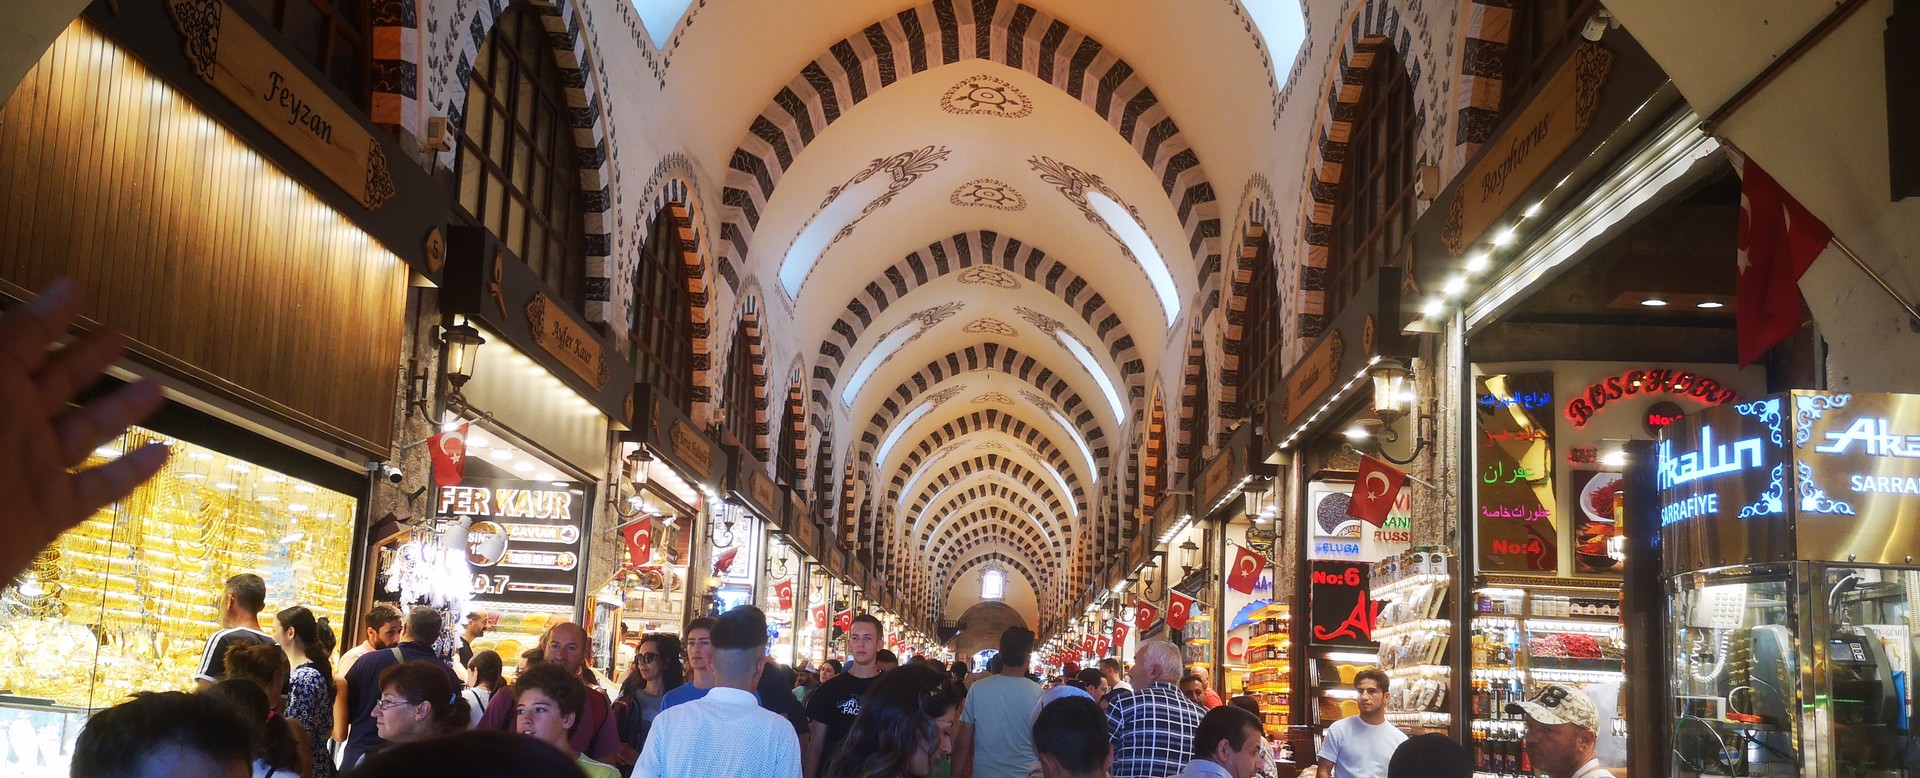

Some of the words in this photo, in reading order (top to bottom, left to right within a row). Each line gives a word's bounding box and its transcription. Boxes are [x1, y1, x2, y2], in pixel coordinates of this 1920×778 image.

[264, 71, 332, 145] Feyzan
[1481, 113, 1549, 204] Bosphorus
[433, 240, 439, 259] 5
[1567, 369, 1742, 428] BOSPHOR
[495, 488, 572, 520] KAUR
[1492, 540, 1540, 554] No:4
[1313, 567, 1361, 587] No:6
